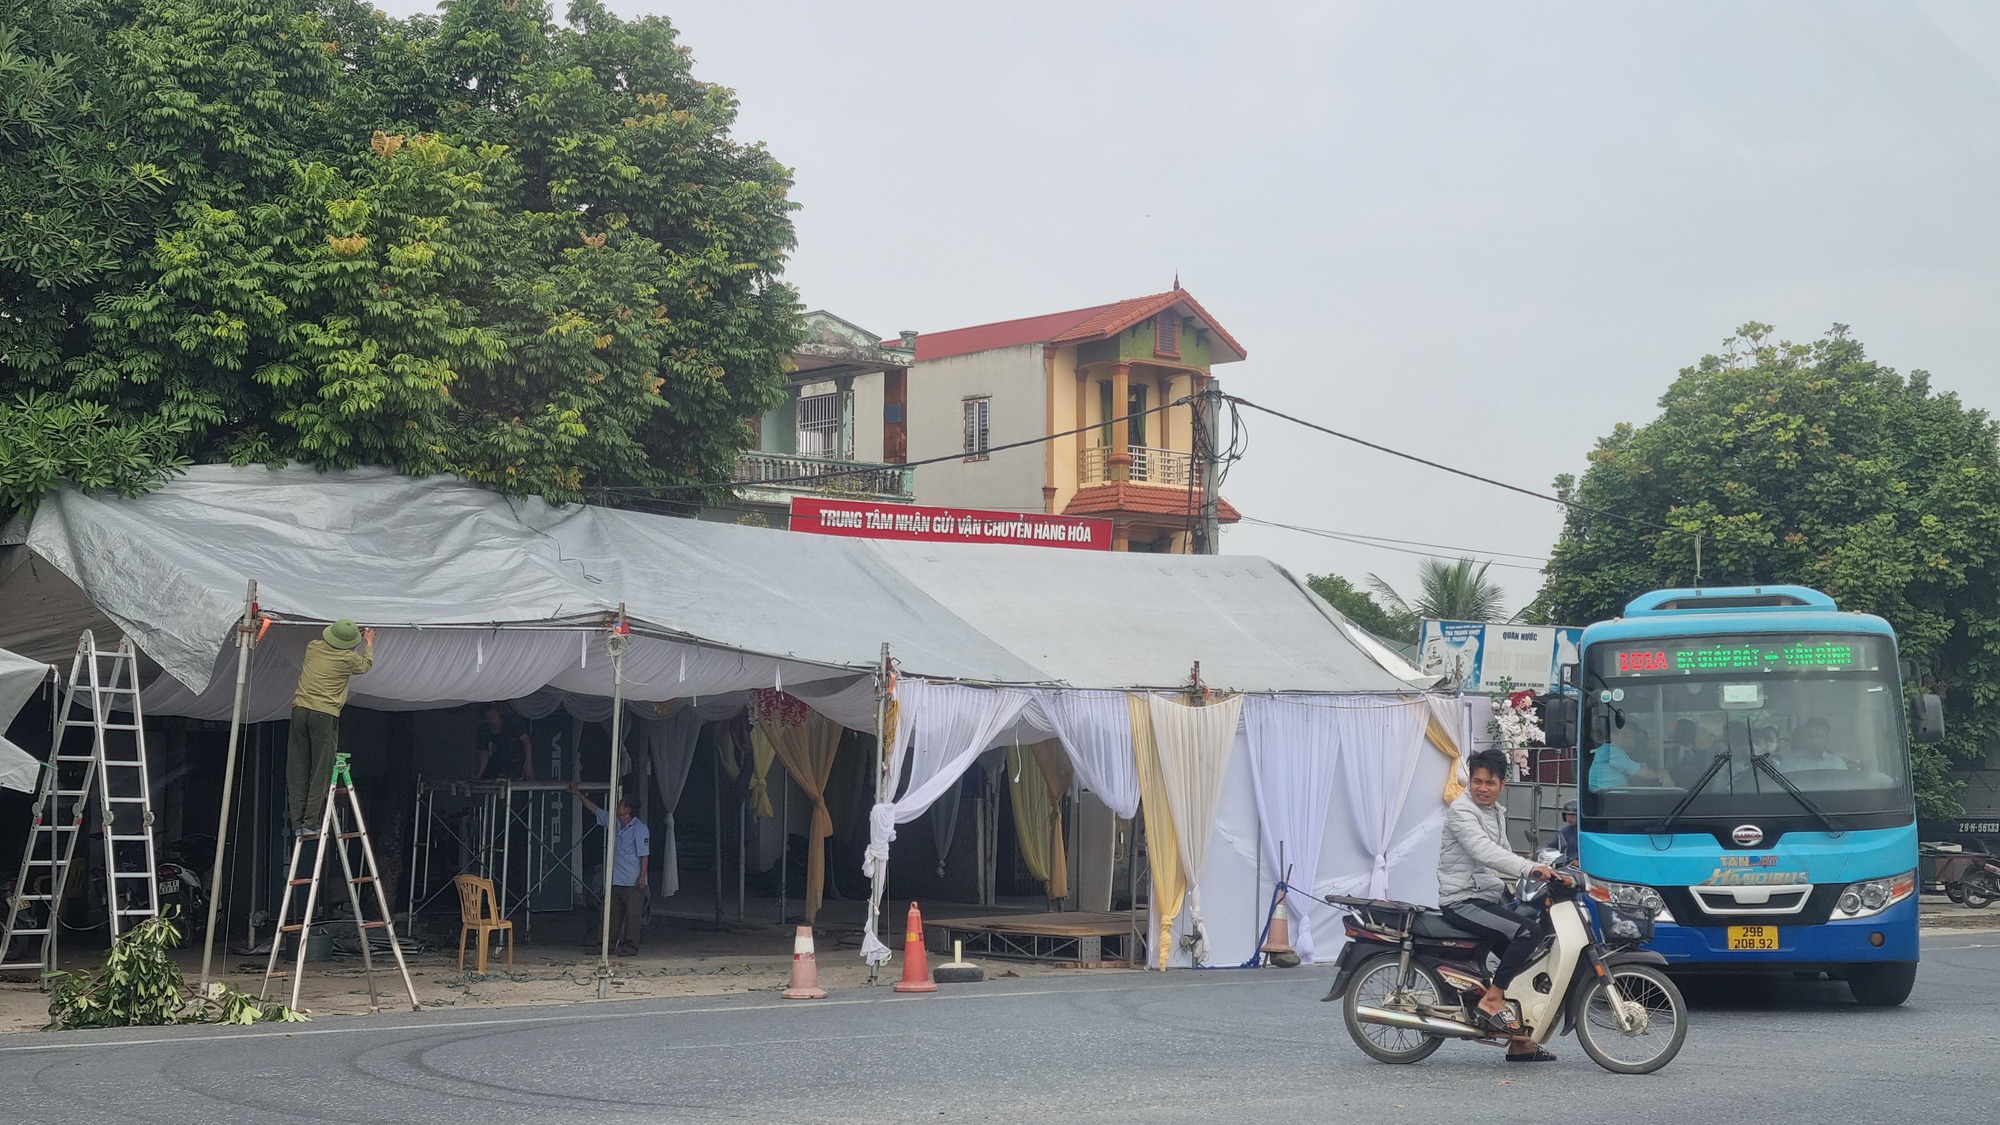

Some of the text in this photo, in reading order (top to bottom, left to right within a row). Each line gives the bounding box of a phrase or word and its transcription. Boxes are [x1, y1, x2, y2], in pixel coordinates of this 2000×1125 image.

[819, 509, 1092, 542] TRUNG TÂM NHẬN GỬI VẬN CHUYỂN HÀNG HÓA
[1503, 631, 1538, 641] QUÁN NƯỚC
[551, 731, 562, 854] VIETEL
[1742, 926, 1764, 937] 29B
[1733, 939, 1773, 949] 208.92
